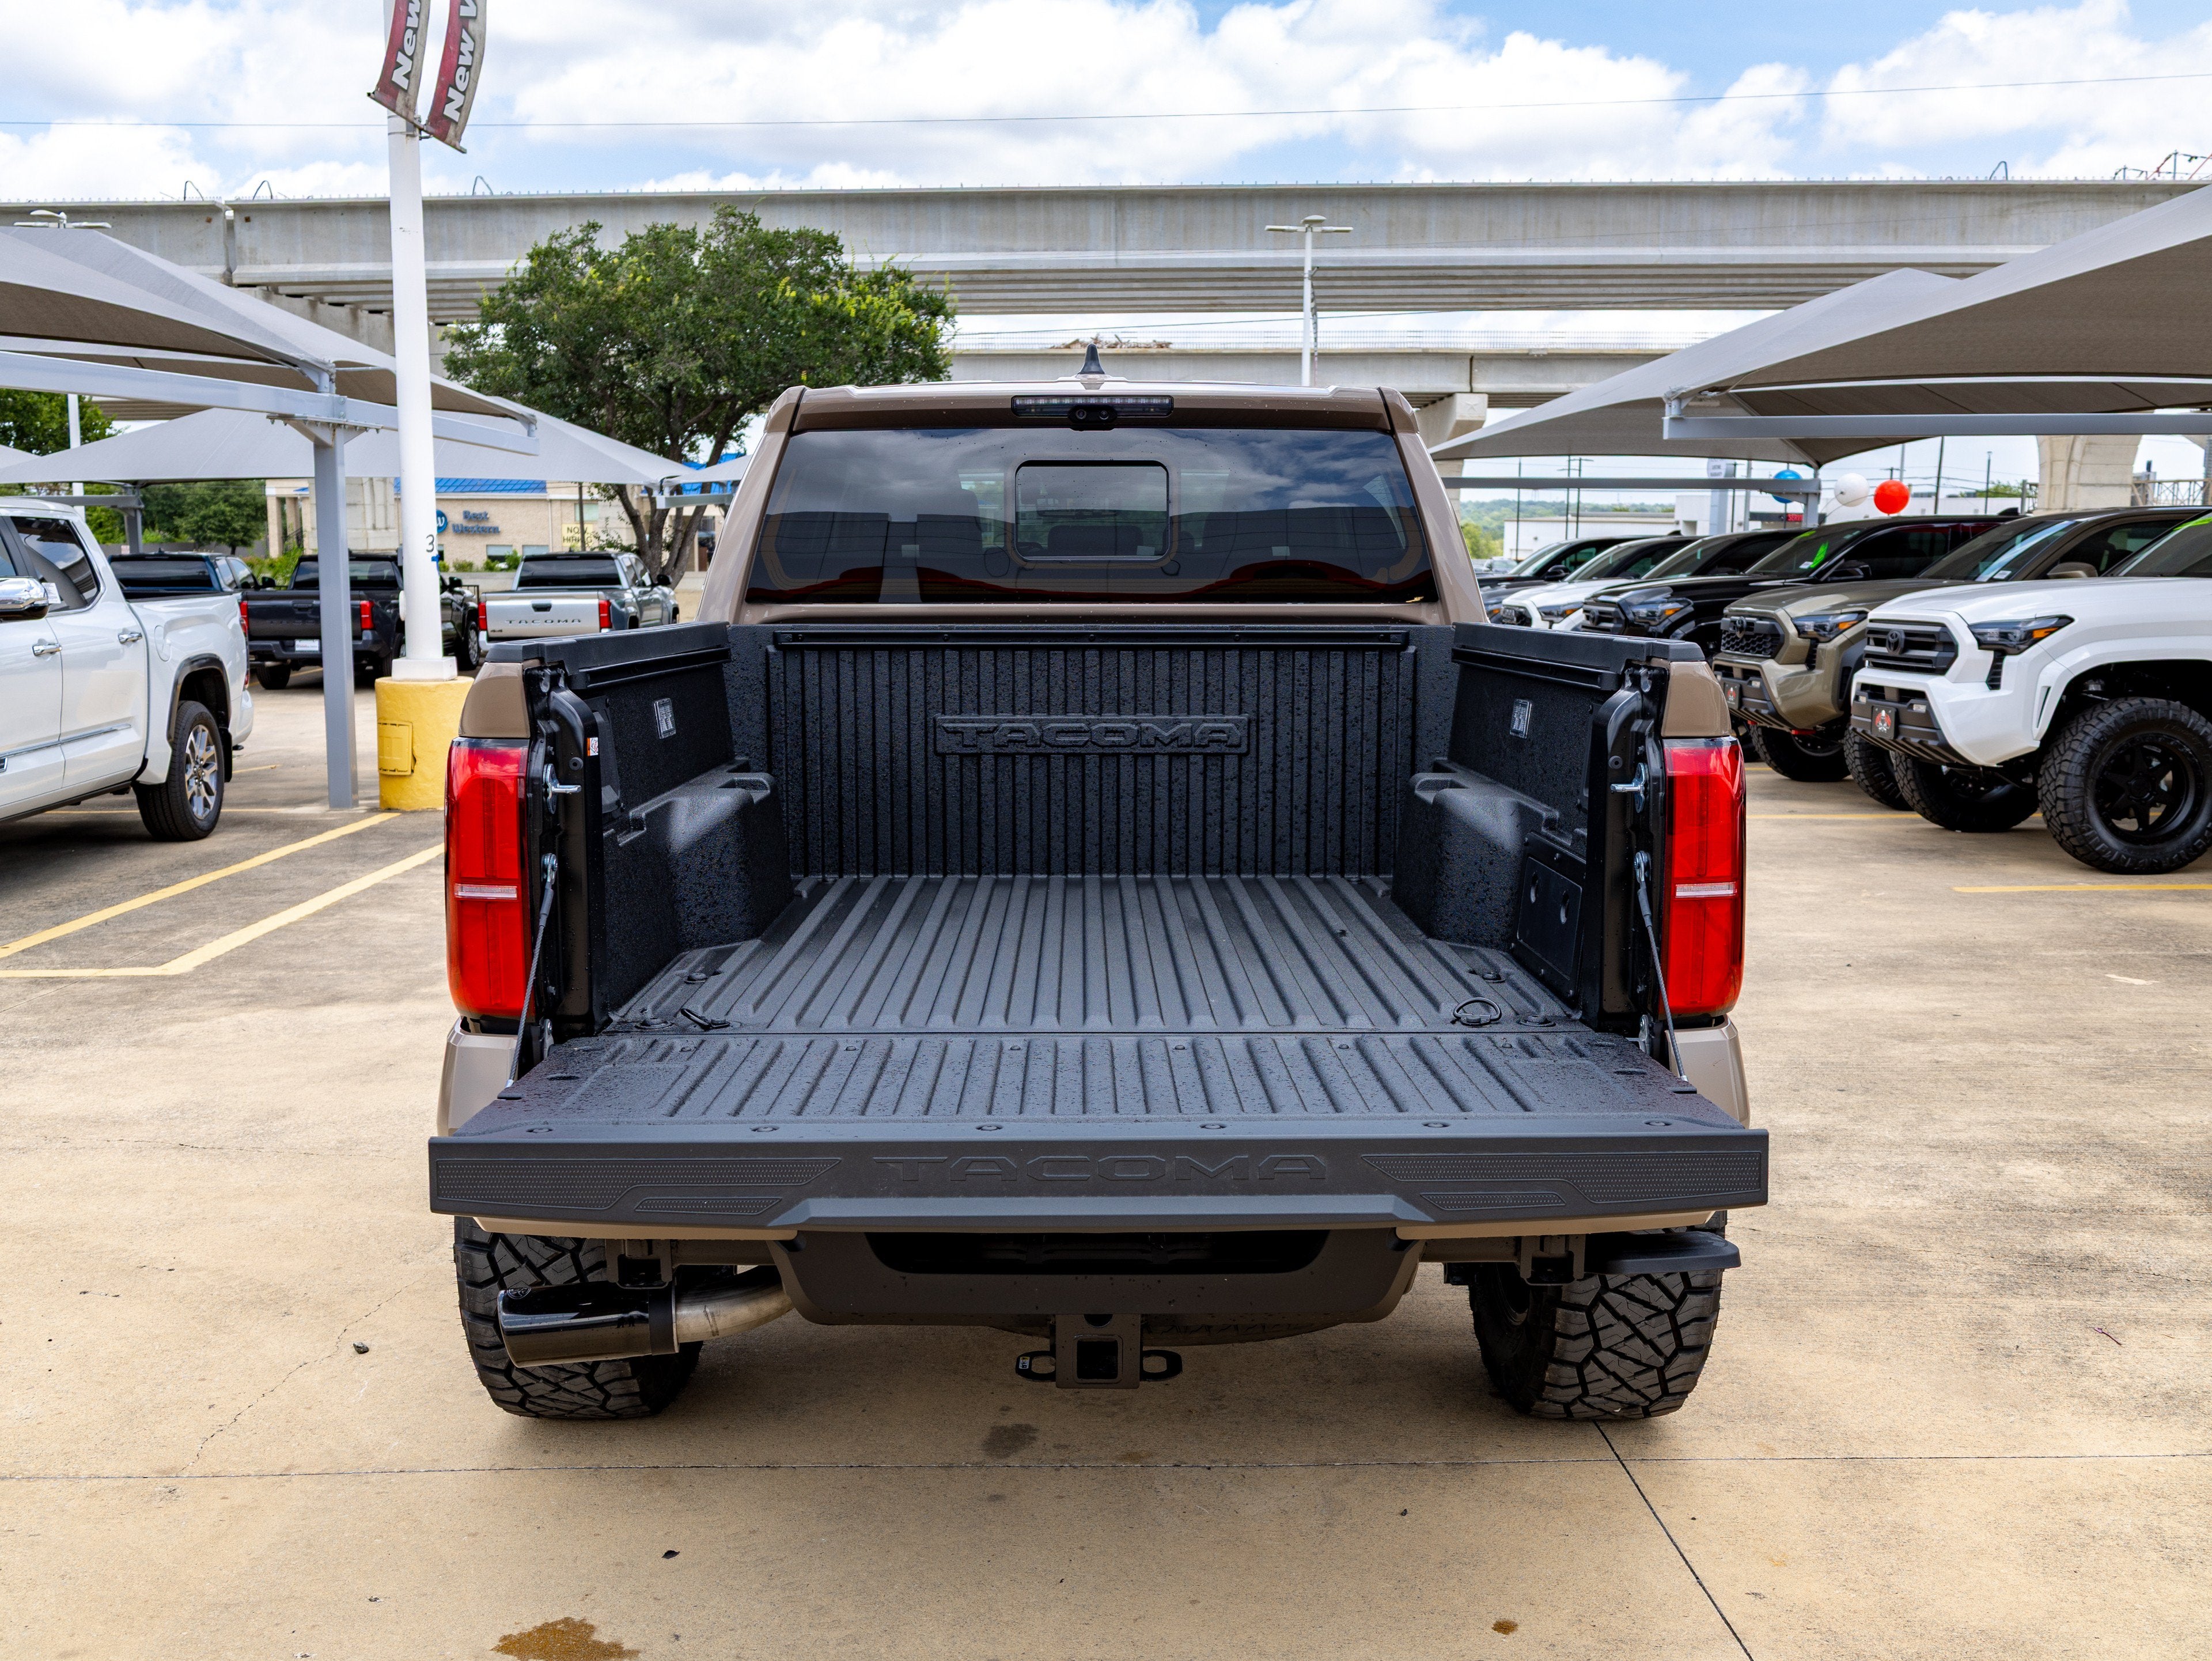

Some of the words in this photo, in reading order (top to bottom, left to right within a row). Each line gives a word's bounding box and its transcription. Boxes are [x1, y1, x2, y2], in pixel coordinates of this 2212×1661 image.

[392, 0, 421, 90] New
[443, 28, 475, 122] New
[452, 523, 500, 534] Western
[463, 510, 489, 521] Best
[426, 534, 434, 553] 3
[941, 722, 1243, 748] TACOMA
[873, 1155, 1326, 1182] TACOMA
